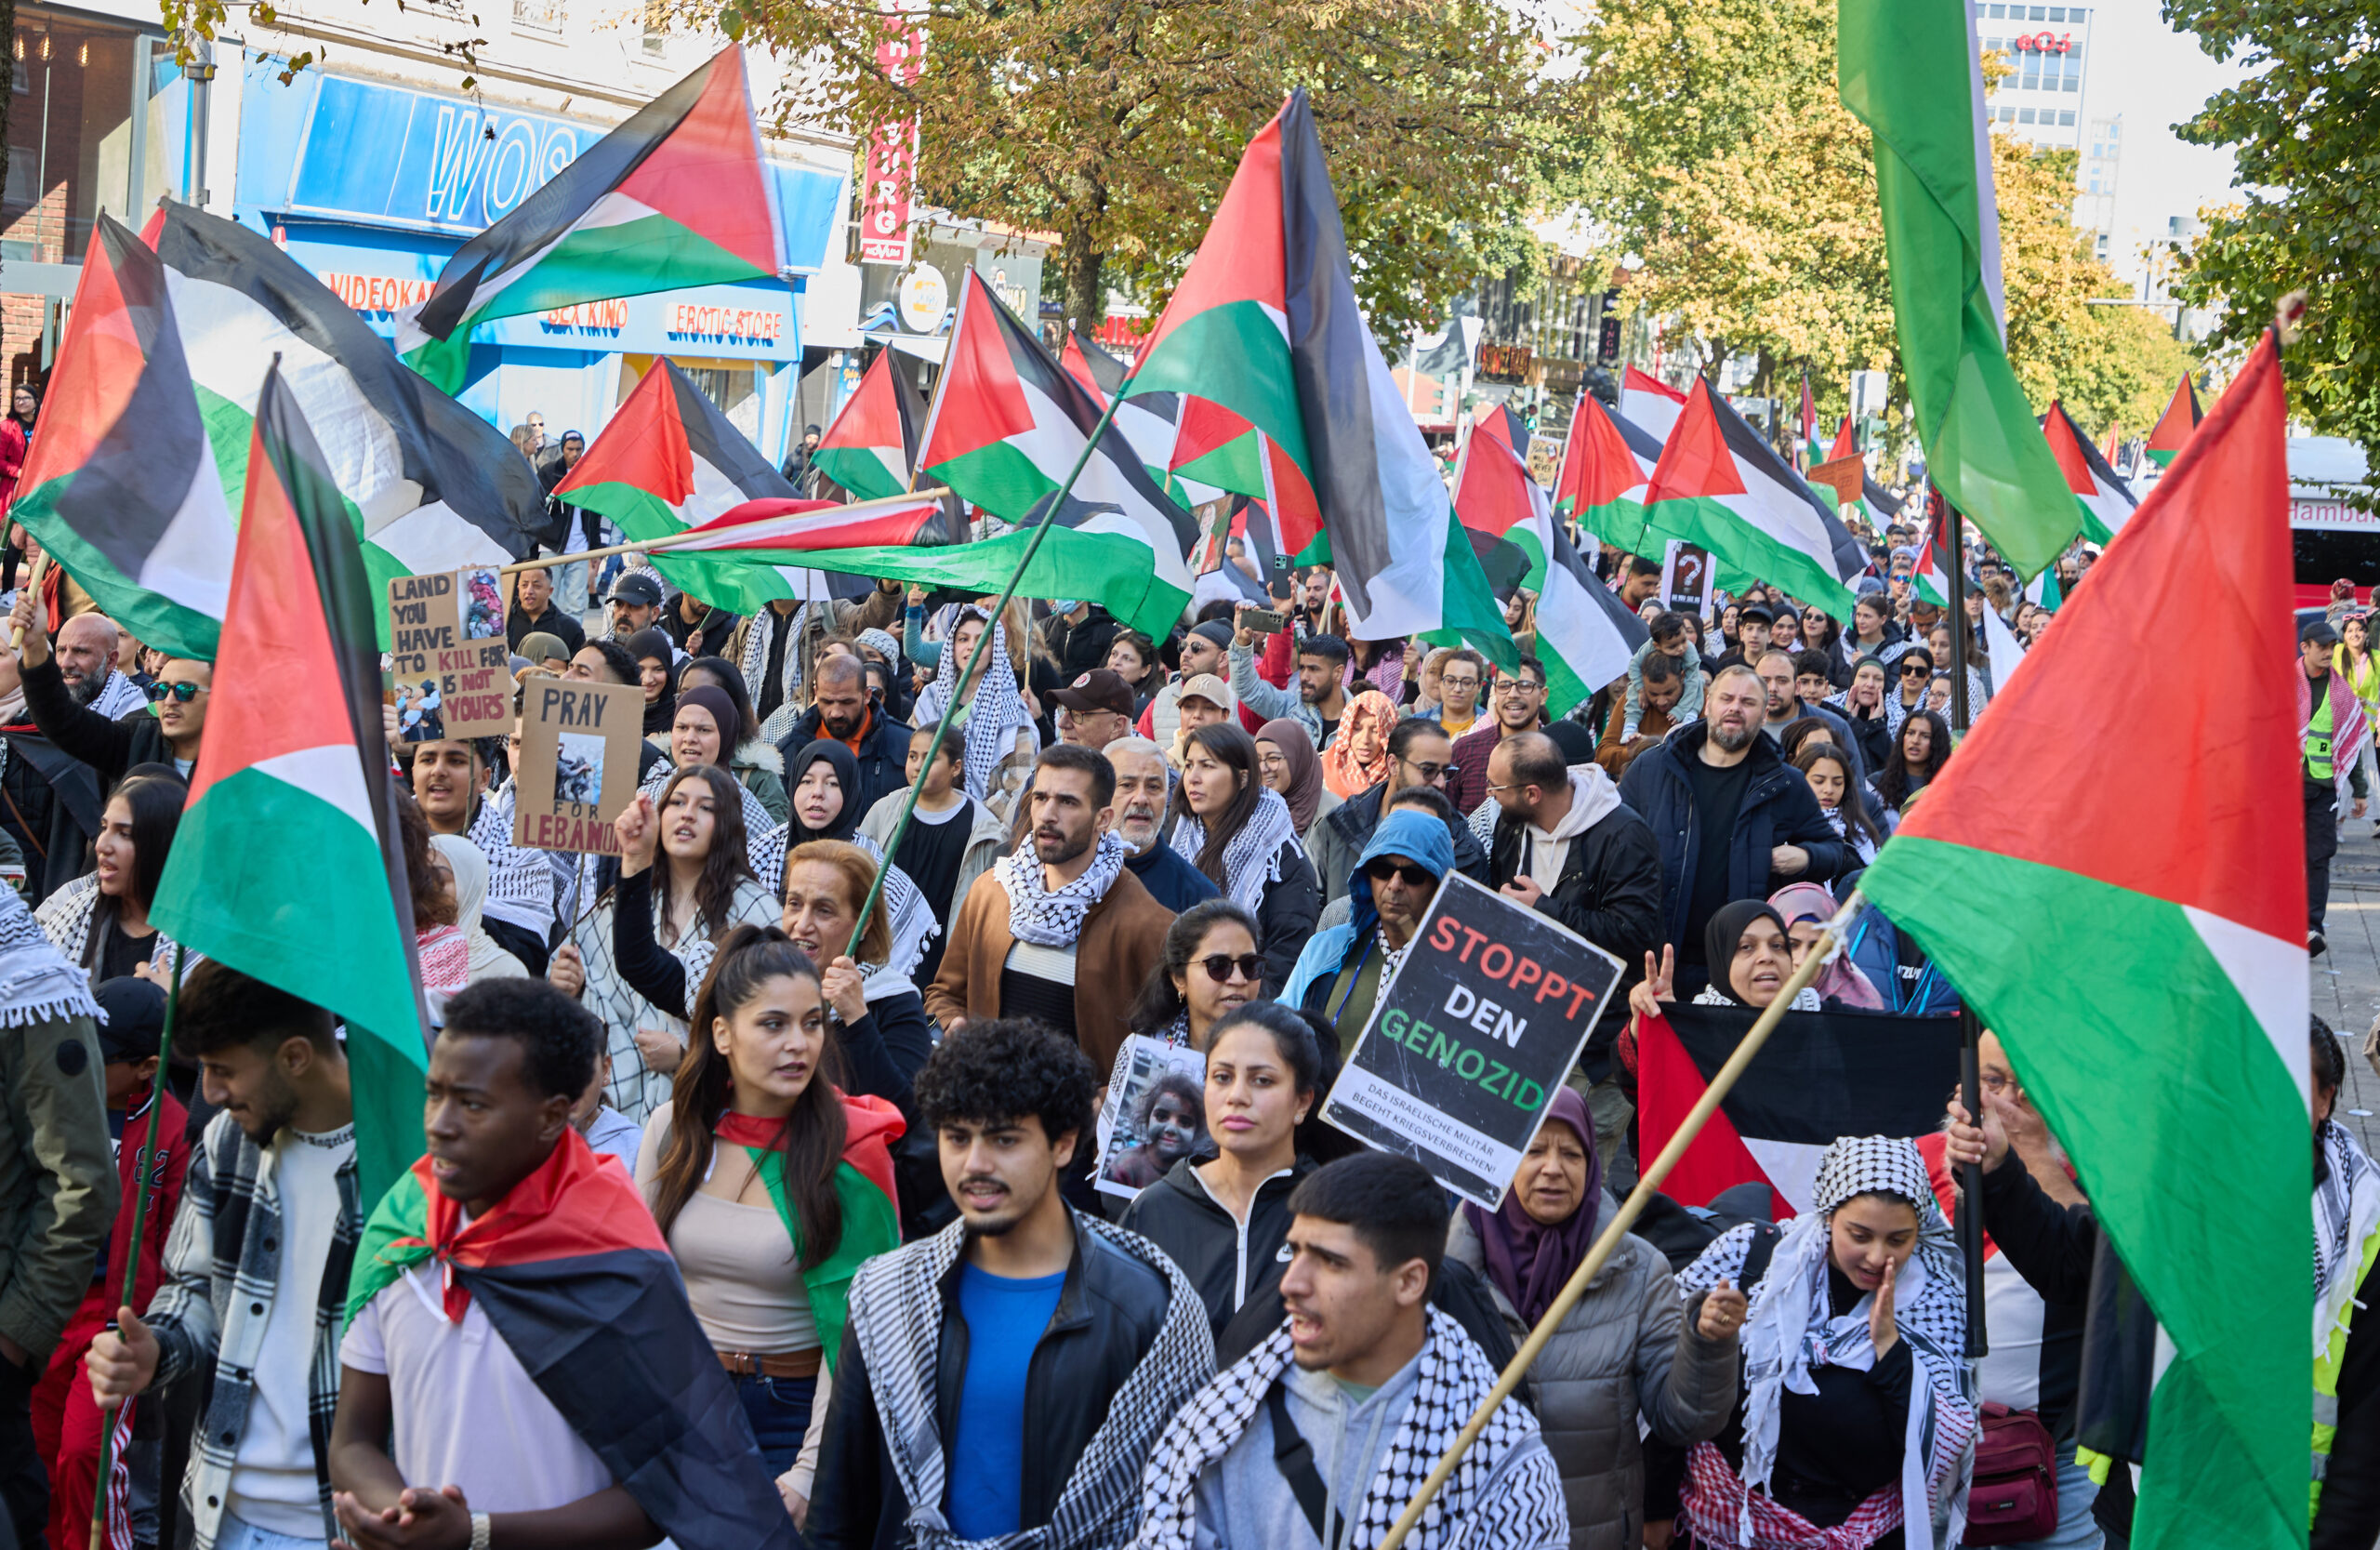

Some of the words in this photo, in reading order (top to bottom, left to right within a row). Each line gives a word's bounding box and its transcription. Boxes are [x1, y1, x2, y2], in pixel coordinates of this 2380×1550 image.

[548, 302, 580, 325] SEX
[588, 298, 628, 328] KINO
[676, 304, 731, 335] EROTIC
[734, 309, 783, 339] STORE
[392, 575, 450, 601] LAND
[392, 602, 427, 625] YOU
[397, 626, 455, 653] HAVE
[395, 653, 426, 674] TO
[438, 649, 475, 671] KILL
[480, 644, 509, 668] FOR
[443, 674, 456, 695] IS
[461, 669, 496, 692] NOT
[445, 693, 505, 722] YOURS
[541, 688, 608, 728] PRAY
[552, 801, 599, 820] FOR
[1428, 916, 1595, 1021] STOPPT
[1443, 984, 1528, 1049] DEN
[1381, 1009, 1544, 1112] GENOZID
[1352, 1092, 1396, 1119] BEGEHT
[1394, 1113, 1497, 1174] KRIEGSVERBRECHEN!
[1368, 1083, 1389, 1101] DAS
[1389, 1094, 1453, 1135] ISRAELISCHE
[1453, 1129, 1495, 1158] MILITÄR
